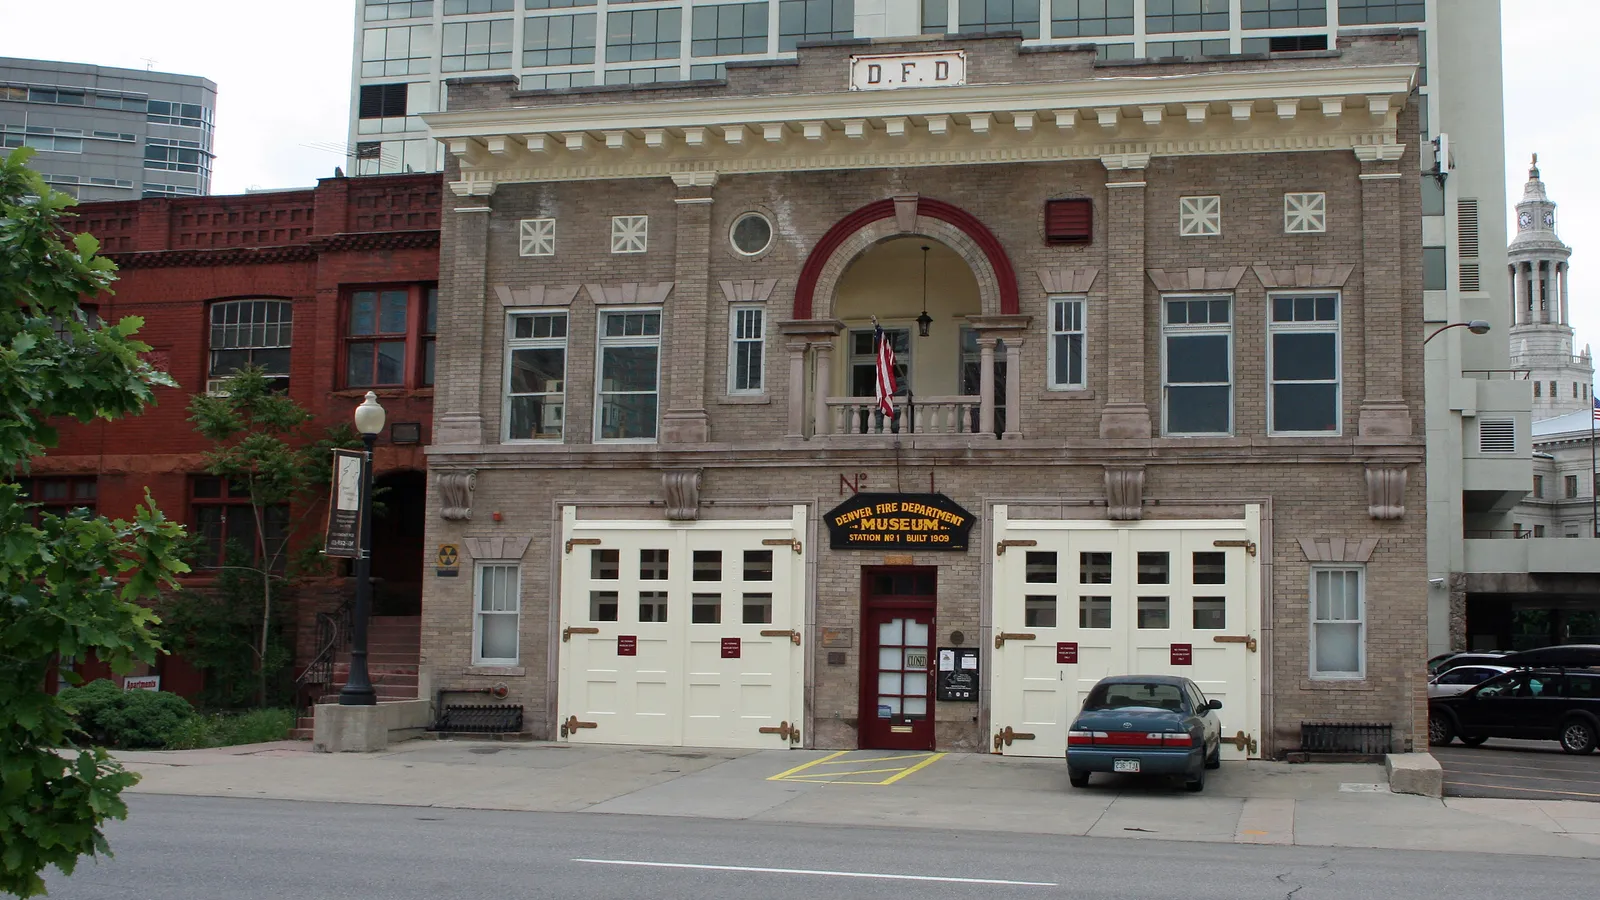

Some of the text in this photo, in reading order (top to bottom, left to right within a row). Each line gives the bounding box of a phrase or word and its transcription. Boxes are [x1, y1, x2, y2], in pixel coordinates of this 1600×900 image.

[835, 502, 965, 527] DENVER FIRE DEPARTMENT
[860, 518, 939, 531] MUSEUM
[849, 534, 881, 542] STATION
[906, 534, 928, 542] BUILT
[930, 534, 950, 542] 1909
